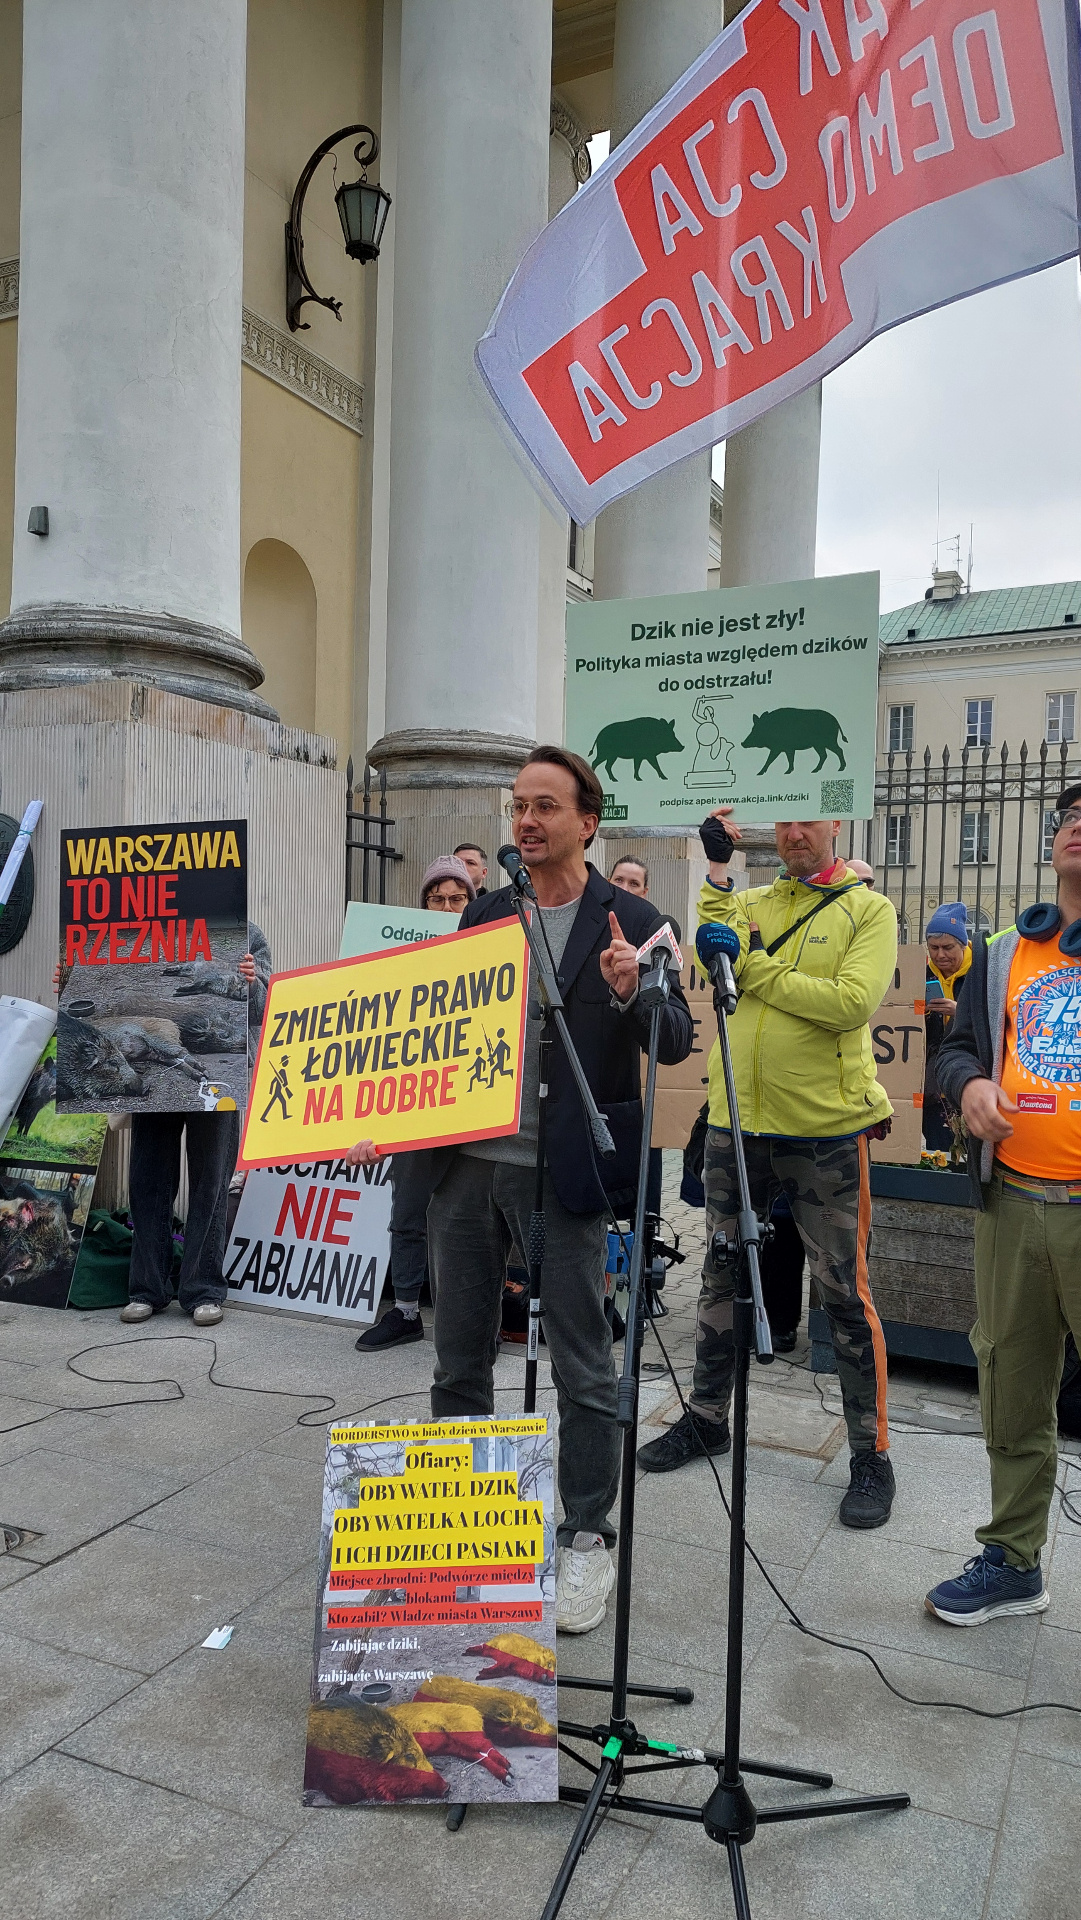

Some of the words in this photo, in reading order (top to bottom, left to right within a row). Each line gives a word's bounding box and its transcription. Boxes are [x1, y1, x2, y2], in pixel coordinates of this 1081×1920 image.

[631, 620, 676, 642] Dzik
[682, 617, 714, 637] nie
[717, 612, 761, 637] jest
[765, 607, 806, 631] zły!
[575, 654, 641, 673] Polityka
[645, 651, 703, 668] miasta
[707, 642, 798, 664] względem
[802, 635, 868, 654] dzików
[658, 676, 680, 692] do
[684, 670, 773, 690] odstrzału!
[660, 798, 694, 807] podpisz
[696, 796, 717, 806] apel:
[718, 793, 810, 804] www.akcja.link/dziki
[66, 830, 241, 876] WARSZAWA
[66, 877, 110, 922] TO
[121, 874, 179, 919] NIE
[66, 913, 213, 966] RZEŹNIA
[710, 937, 735, 947] news
[1042, 967, 1080, 983] POLSCE
[269, 989, 402, 1048] ZMIEŃMY
[409, 962, 516, 1022] PRAWO
[300, 1017, 472, 1083] ŁOWIECKIE
[1017, 1038, 1039, 1072] POLICZ
[1036, 1064, 1058, 1083] SIĘ
[1060, 1069, 1068, 1081] Z
[1043, 1055, 1081, 1064] 10.01.20
[302, 1084, 344, 1126] NA
[354, 1065, 459, 1119] DOBRE
[1019, 1100, 1053, 1110] Dawtona
[274, 1183, 361, 1246] NIE
[225, 1237, 378, 1312] ZABIJANIA
[331, 1428, 410, 1442] MORDERSTWO
[411, 1428, 422, 1437] w
[422, 1425, 447, 1439] biały
[449, 1423, 478, 1437] dzień
[479, 1425, 488, 1435] w
[490, 1421, 545, 1435] Warszawie
[405, 1452, 469, 1472] Ofiary:
[360, 1480, 466, 1502] OBYWATEL
[470, 1478, 517, 1497] DZIK
[334, 1511, 469, 1533] OBYWATELKA
[473, 1508, 543, 1528] LOCHA
[334, 1547, 342, 1564] I
[346, 1545, 381, 1564] ICH
[386, 1542, 453, 1563] DZIECI
[456, 1539, 537, 1560] PASIAKI
[330, 1571, 374, 1589] Miejsce
[376, 1571, 427, 1585] zbrodni:
[429, 1569, 489, 1584] Podwórze
[491, 1567, 535, 1583] między
[406, 1591, 456, 1604] blokami
[327, 1612, 349, 1625] Kto
[351, 1610, 387, 1624] zabił?
[390, 1608, 435, 1622] Władze
[437, 1607, 478, 1621] miasta
[480, 1606, 542, 1622] Warszawy
[330, 1639, 387, 1654] Zabijając
[387, 1637, 421, 1651] dziki,
[318, 1669, 372, 1685] zabijacie
[374, 1668, 434, 1683] Warszawę
